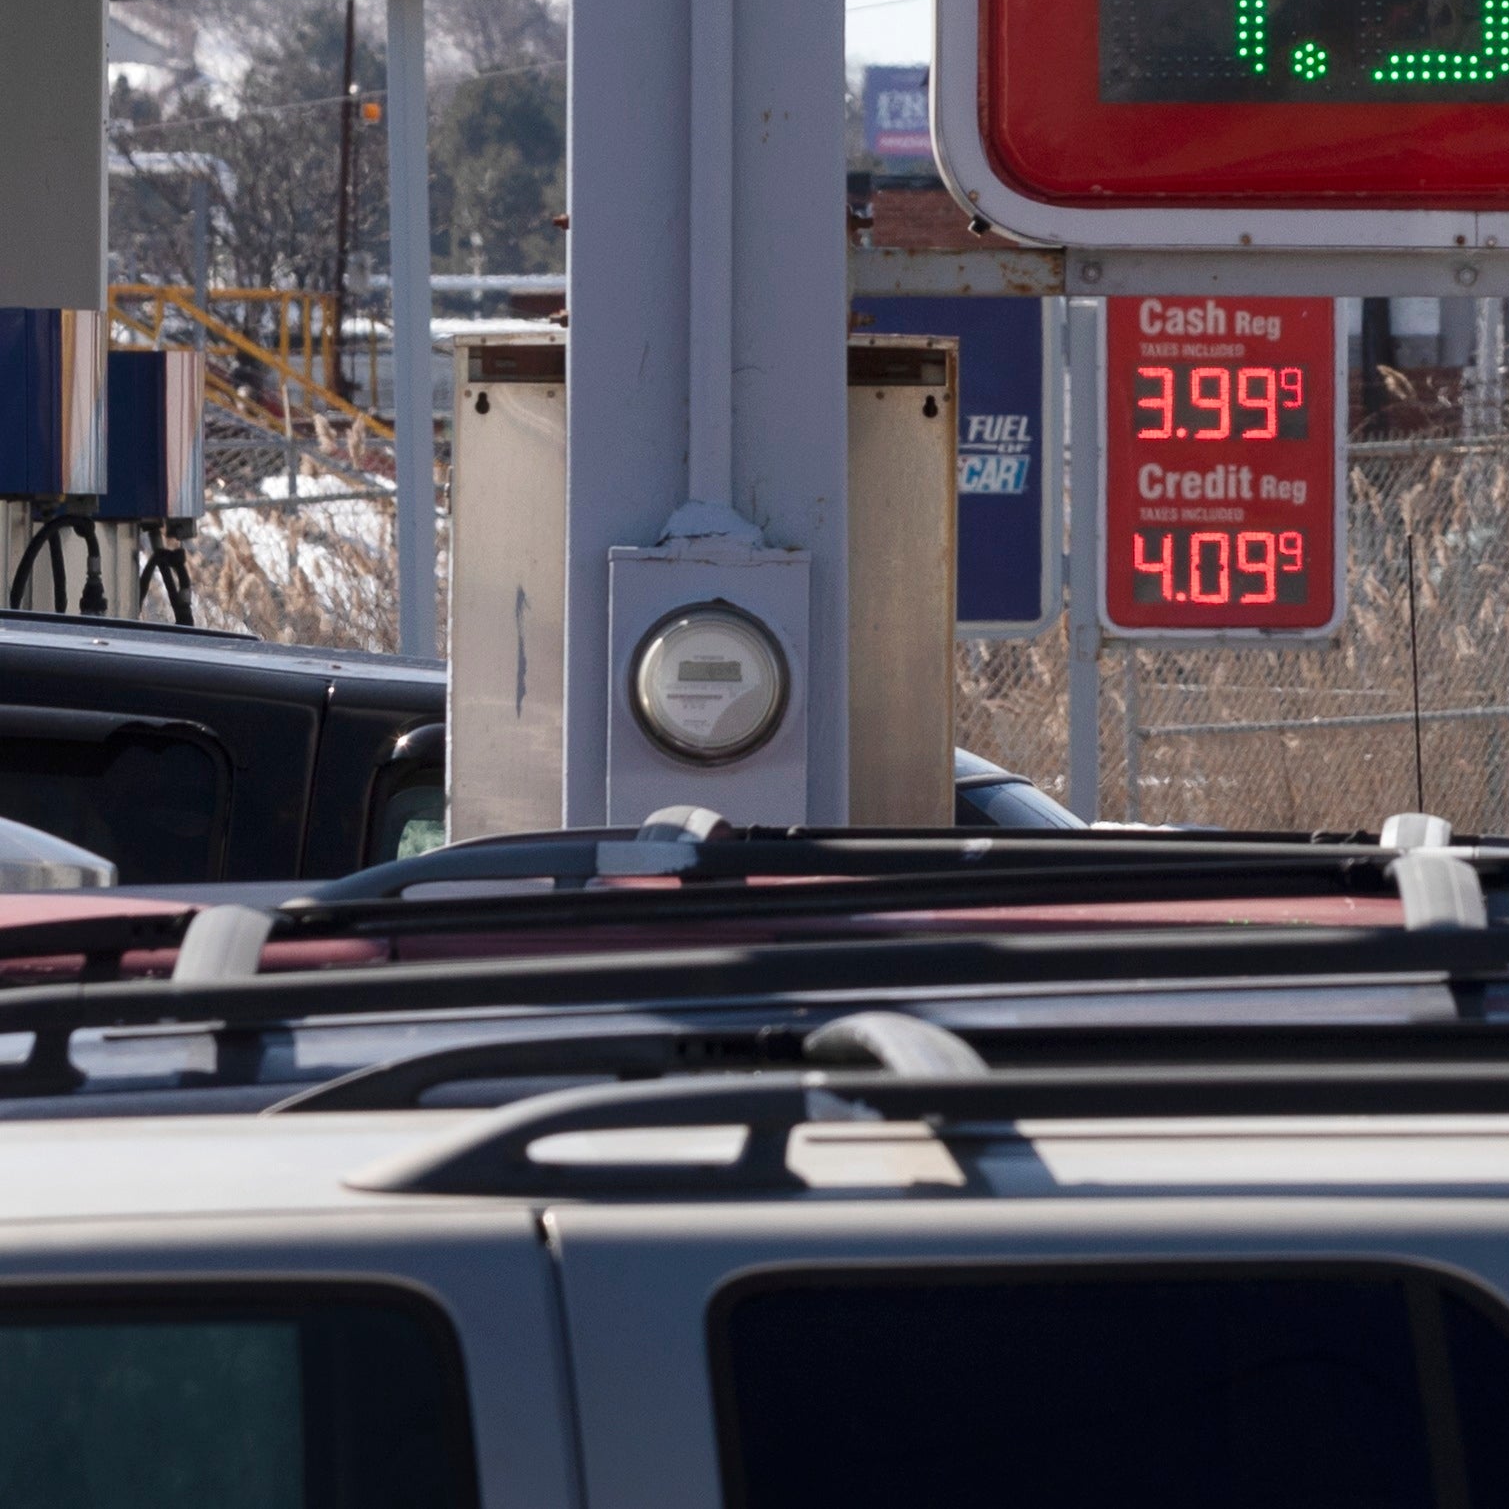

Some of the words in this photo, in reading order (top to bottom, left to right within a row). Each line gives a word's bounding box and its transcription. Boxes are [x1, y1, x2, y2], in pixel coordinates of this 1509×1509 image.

[1138, 298, 1229, 336] Cash
[1234, 310, 1282, 341] Reg
[1140, 343, 1179, 358] TAXES
[1182, 343, 1246, 358] INCLUDED
[967, 415, 1033, 442] FUEL
[1138, 463, 1253, 500] Credit
[1259, 474, 1308, 506] Reg
[1140, 507, 1179, 522] TAXES
[1181, 507, 1246, 522] INCLUDED
